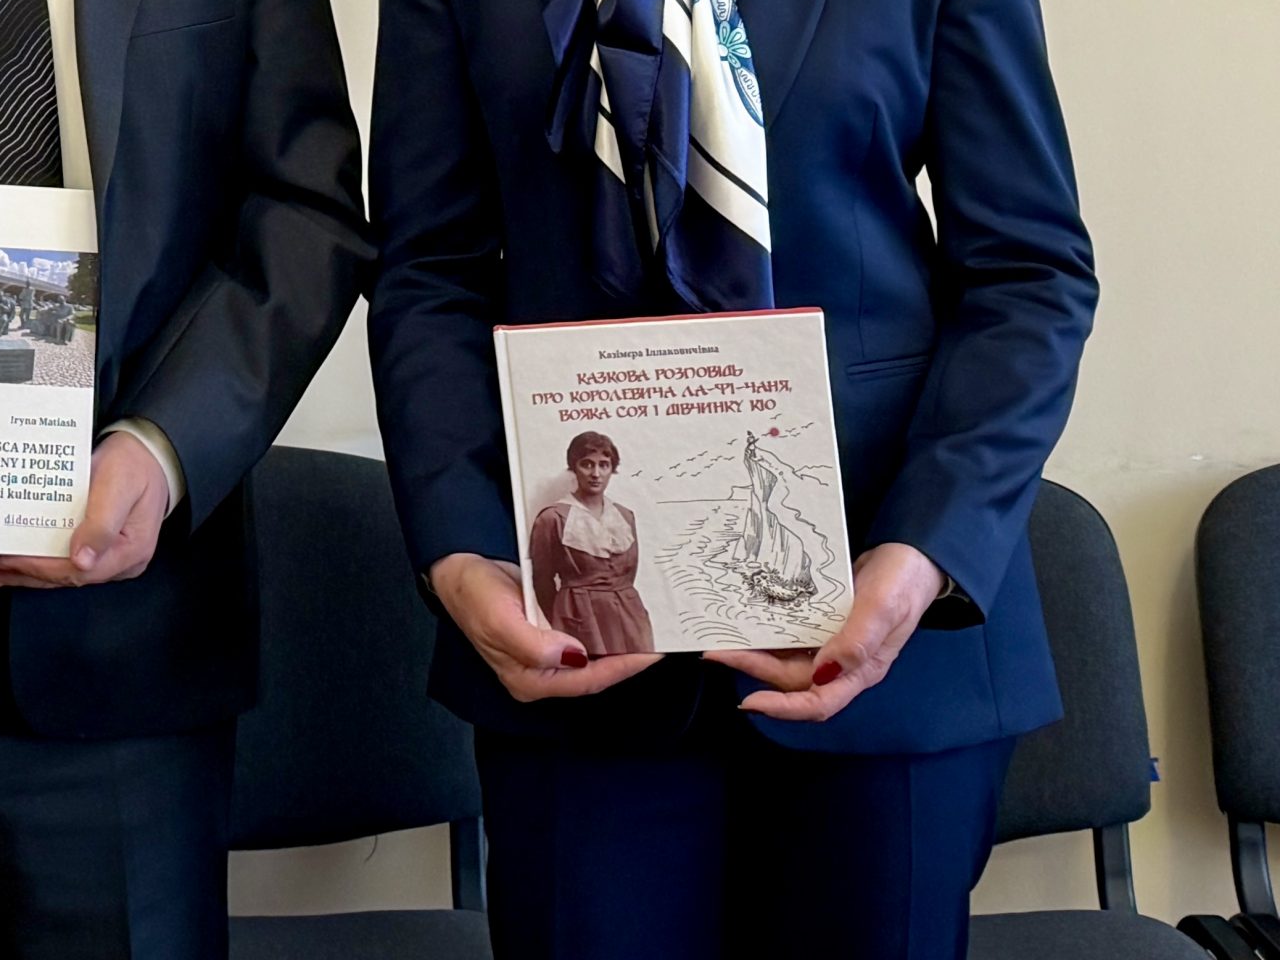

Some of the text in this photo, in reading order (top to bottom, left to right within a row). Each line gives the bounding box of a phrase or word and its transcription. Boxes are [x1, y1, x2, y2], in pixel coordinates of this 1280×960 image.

[598, 350, 643, 360] Казімера
[577, 364, 743, 385] КАЗКОВА РОЗПОВІДЬ
[532, 392, 564, 405] ПРО
[569, 385, 677, 403] КОРОЛЕВИЧА
[559, 407, 611, 422] ВОЯКА
[616, 405, 648, 418] СОЯ
[665, 400, 743, 416] ДІВЧИНКУ
[10, 415, 77, 428] Iryna Matiash
[22, 442, 76, 458] PAMIĘCI
[21, 459, 26, 469] I
[29, 460, 74, 472] POLSKI
[21, 472, 74, 488] oficjalna
[0, 487, 73, 503] i kulturalna
[4, 514, 74, 528] didactica 18
